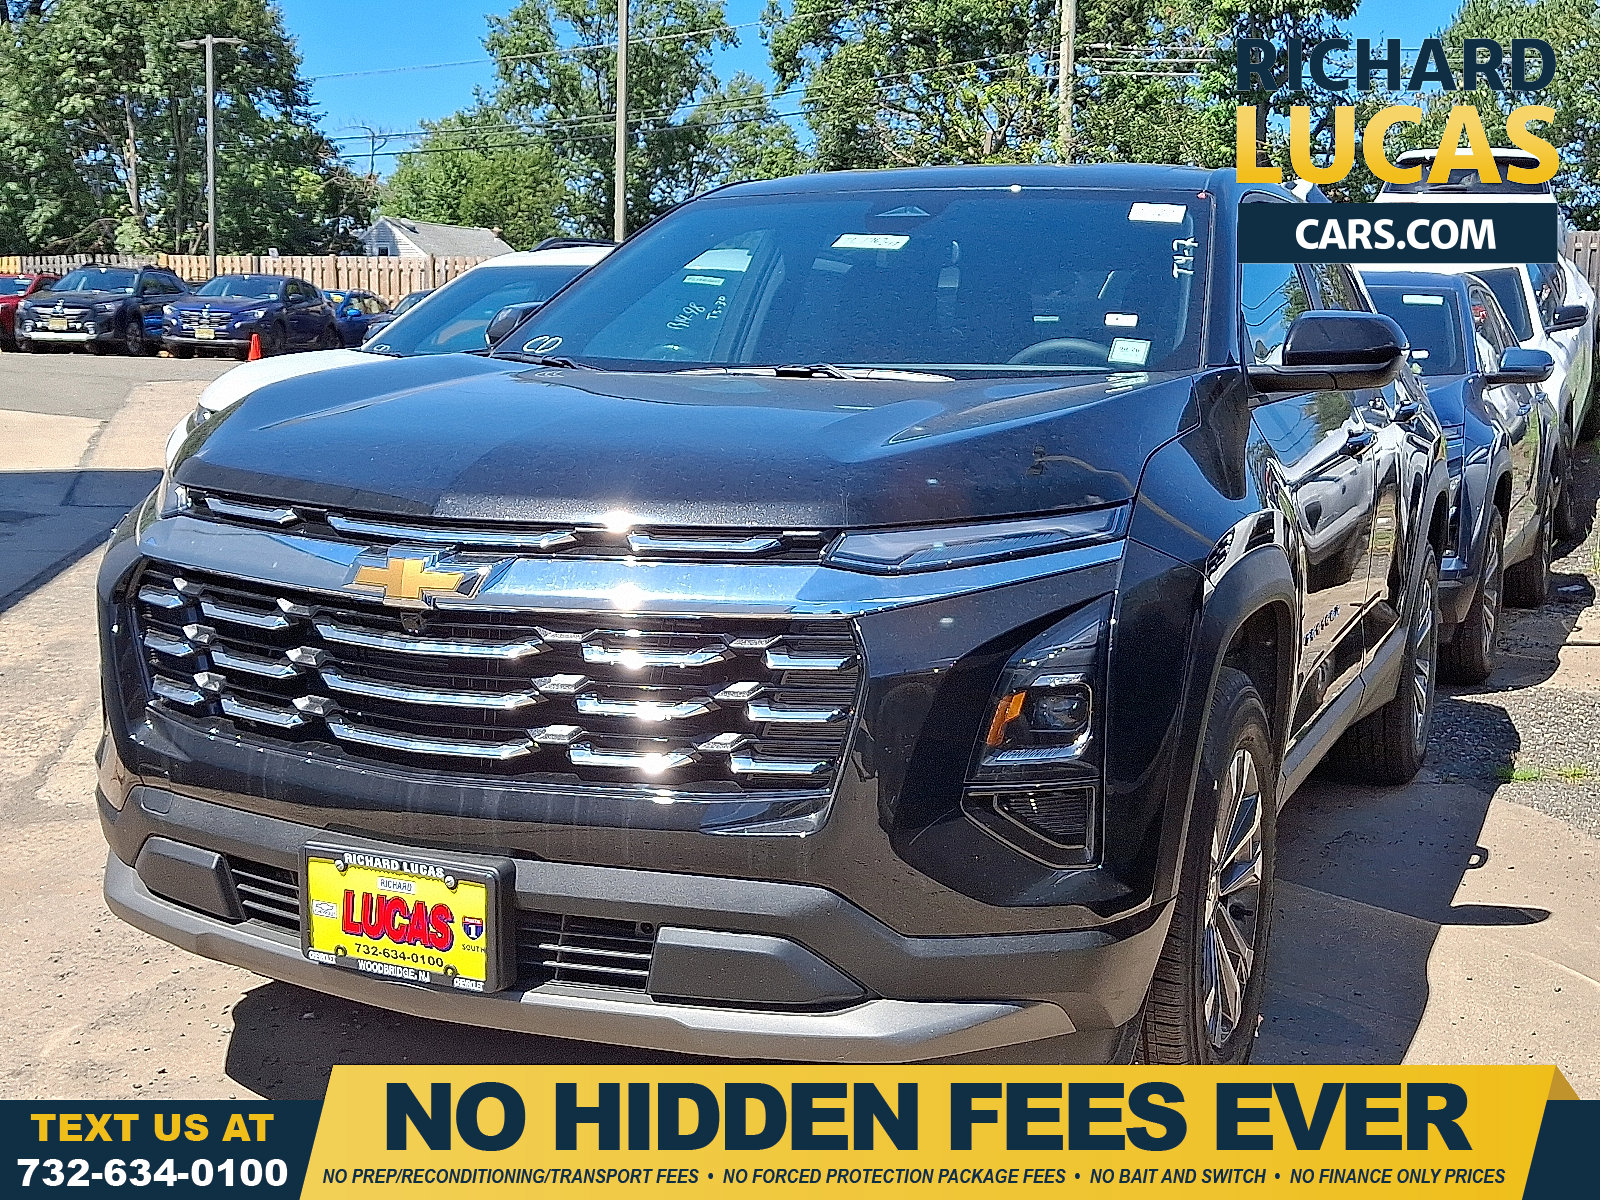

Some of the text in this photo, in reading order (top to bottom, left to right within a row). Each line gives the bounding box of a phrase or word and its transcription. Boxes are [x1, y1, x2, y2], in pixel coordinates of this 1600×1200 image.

[343, 852, 445, 879] RICHARD LUCAS
[380, 878, 413, 892] RICHARD
[341, 888, 455, 952] LUCAS
[468, 924, 478, 939] 1
[354, 943, 444, 968] 732-634-0100
[418, 970, 431, 983] NJ
